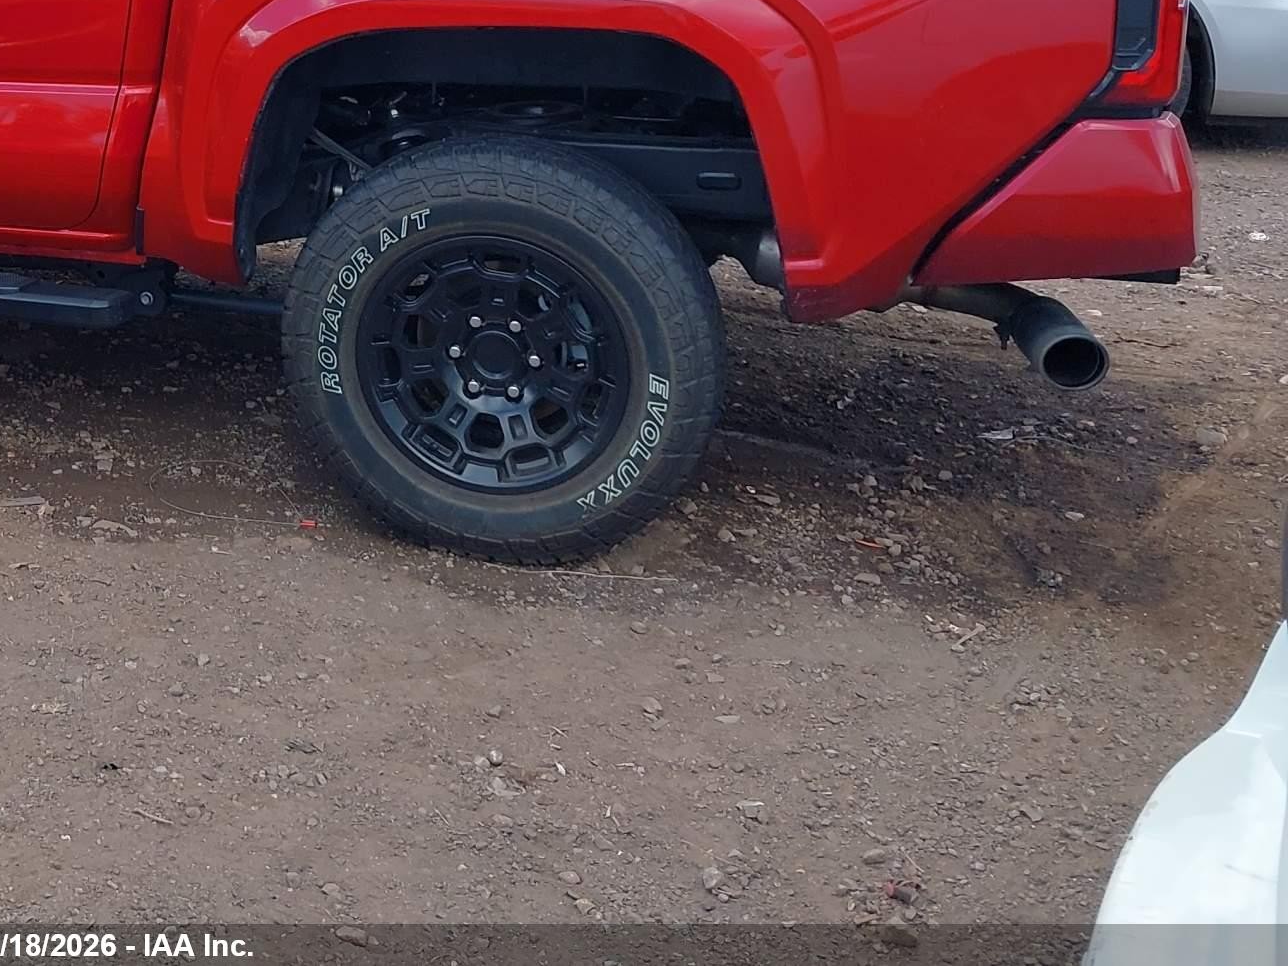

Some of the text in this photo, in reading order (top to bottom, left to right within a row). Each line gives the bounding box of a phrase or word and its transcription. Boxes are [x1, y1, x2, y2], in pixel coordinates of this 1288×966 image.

[316, 208, 431, 395] ROTATOR A/T
[576, 372, 670, 515] EVOLUXX
